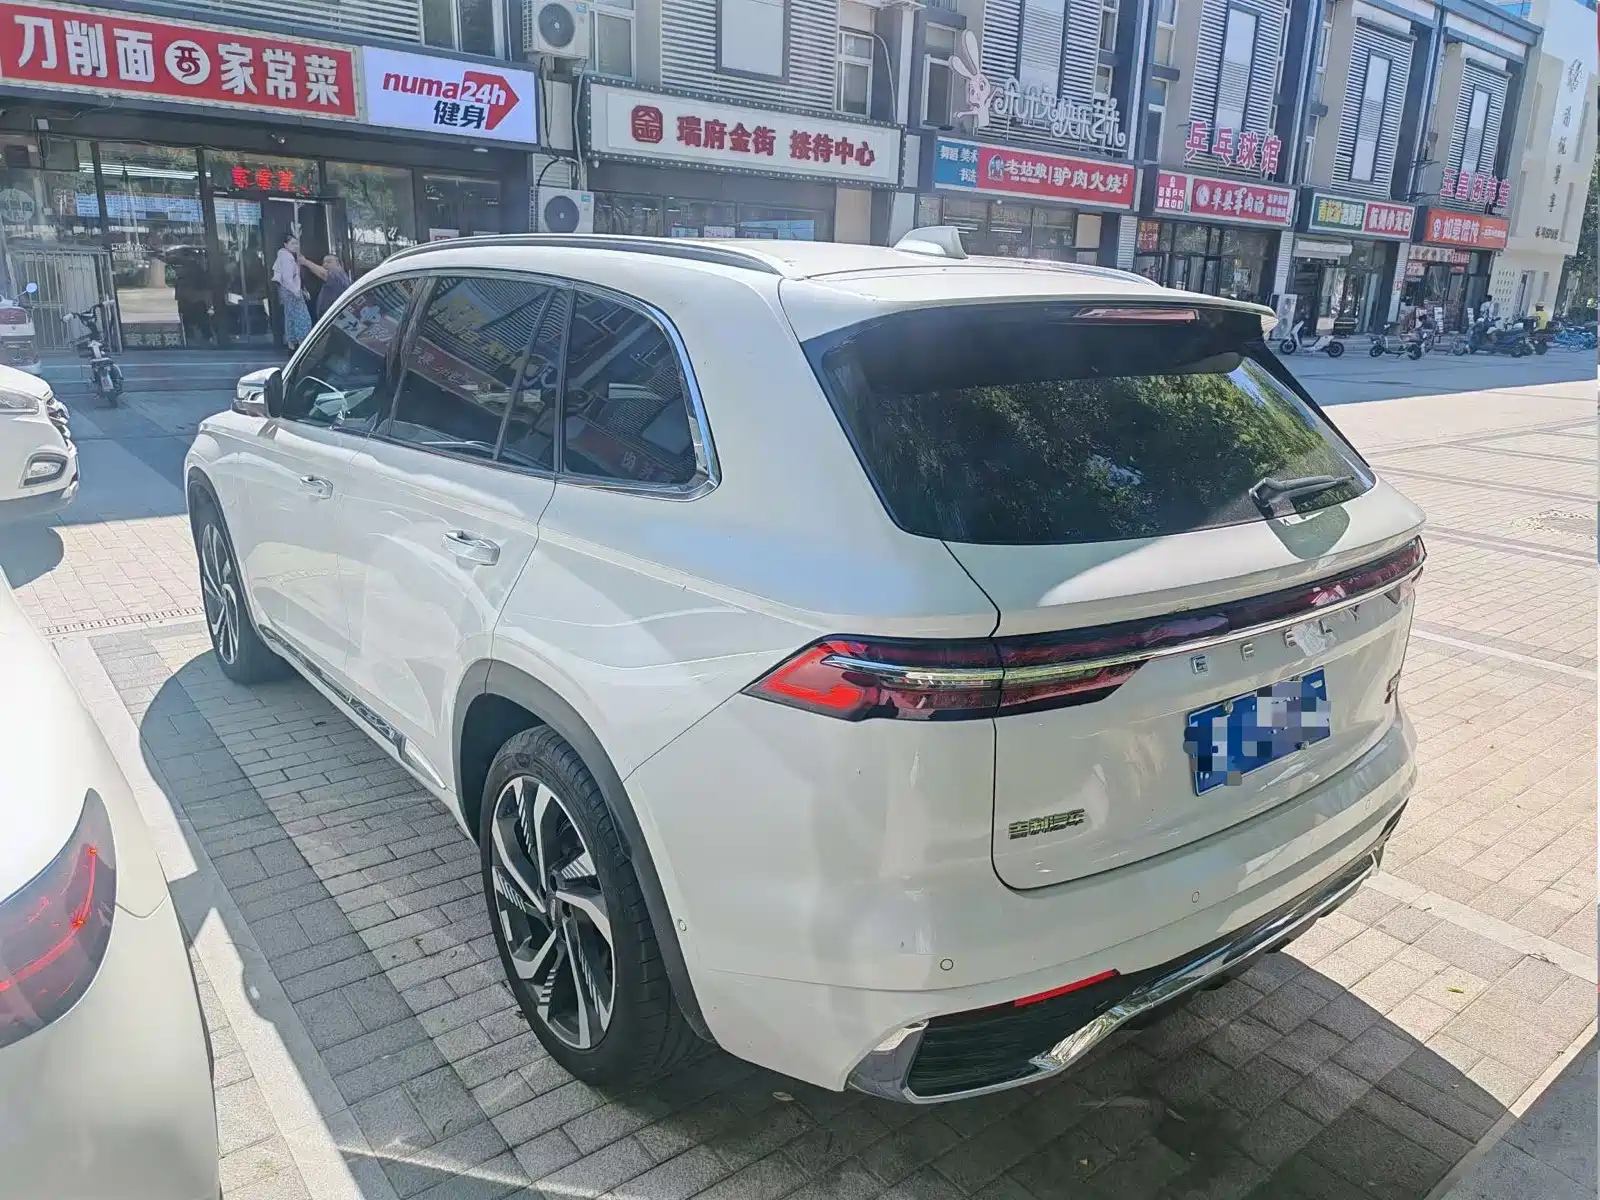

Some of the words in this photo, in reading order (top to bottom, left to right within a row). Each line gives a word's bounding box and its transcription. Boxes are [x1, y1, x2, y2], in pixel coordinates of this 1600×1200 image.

[14, 15, 156, 83] 刀削面
[217, 42, 341, 106] 家常菜
[382, 70, 507, 106] numa24h
[433, 100, 487, 130] 健身
[677, 115, 777, 157] 瑞府金街
[789, 130, 876, 167] 接待中心
[960, 147, 979, 163] 美术
[1185, 121, 1282, 175] 乒乓球馆
[958, 167, 978, 184] 书法
[1052, 166, 1123, 194] 驴肉火烧
[1442, 216, 1481, 244] 如意馄饨
[1008, 808, 1086, 841] 吉利汽车
